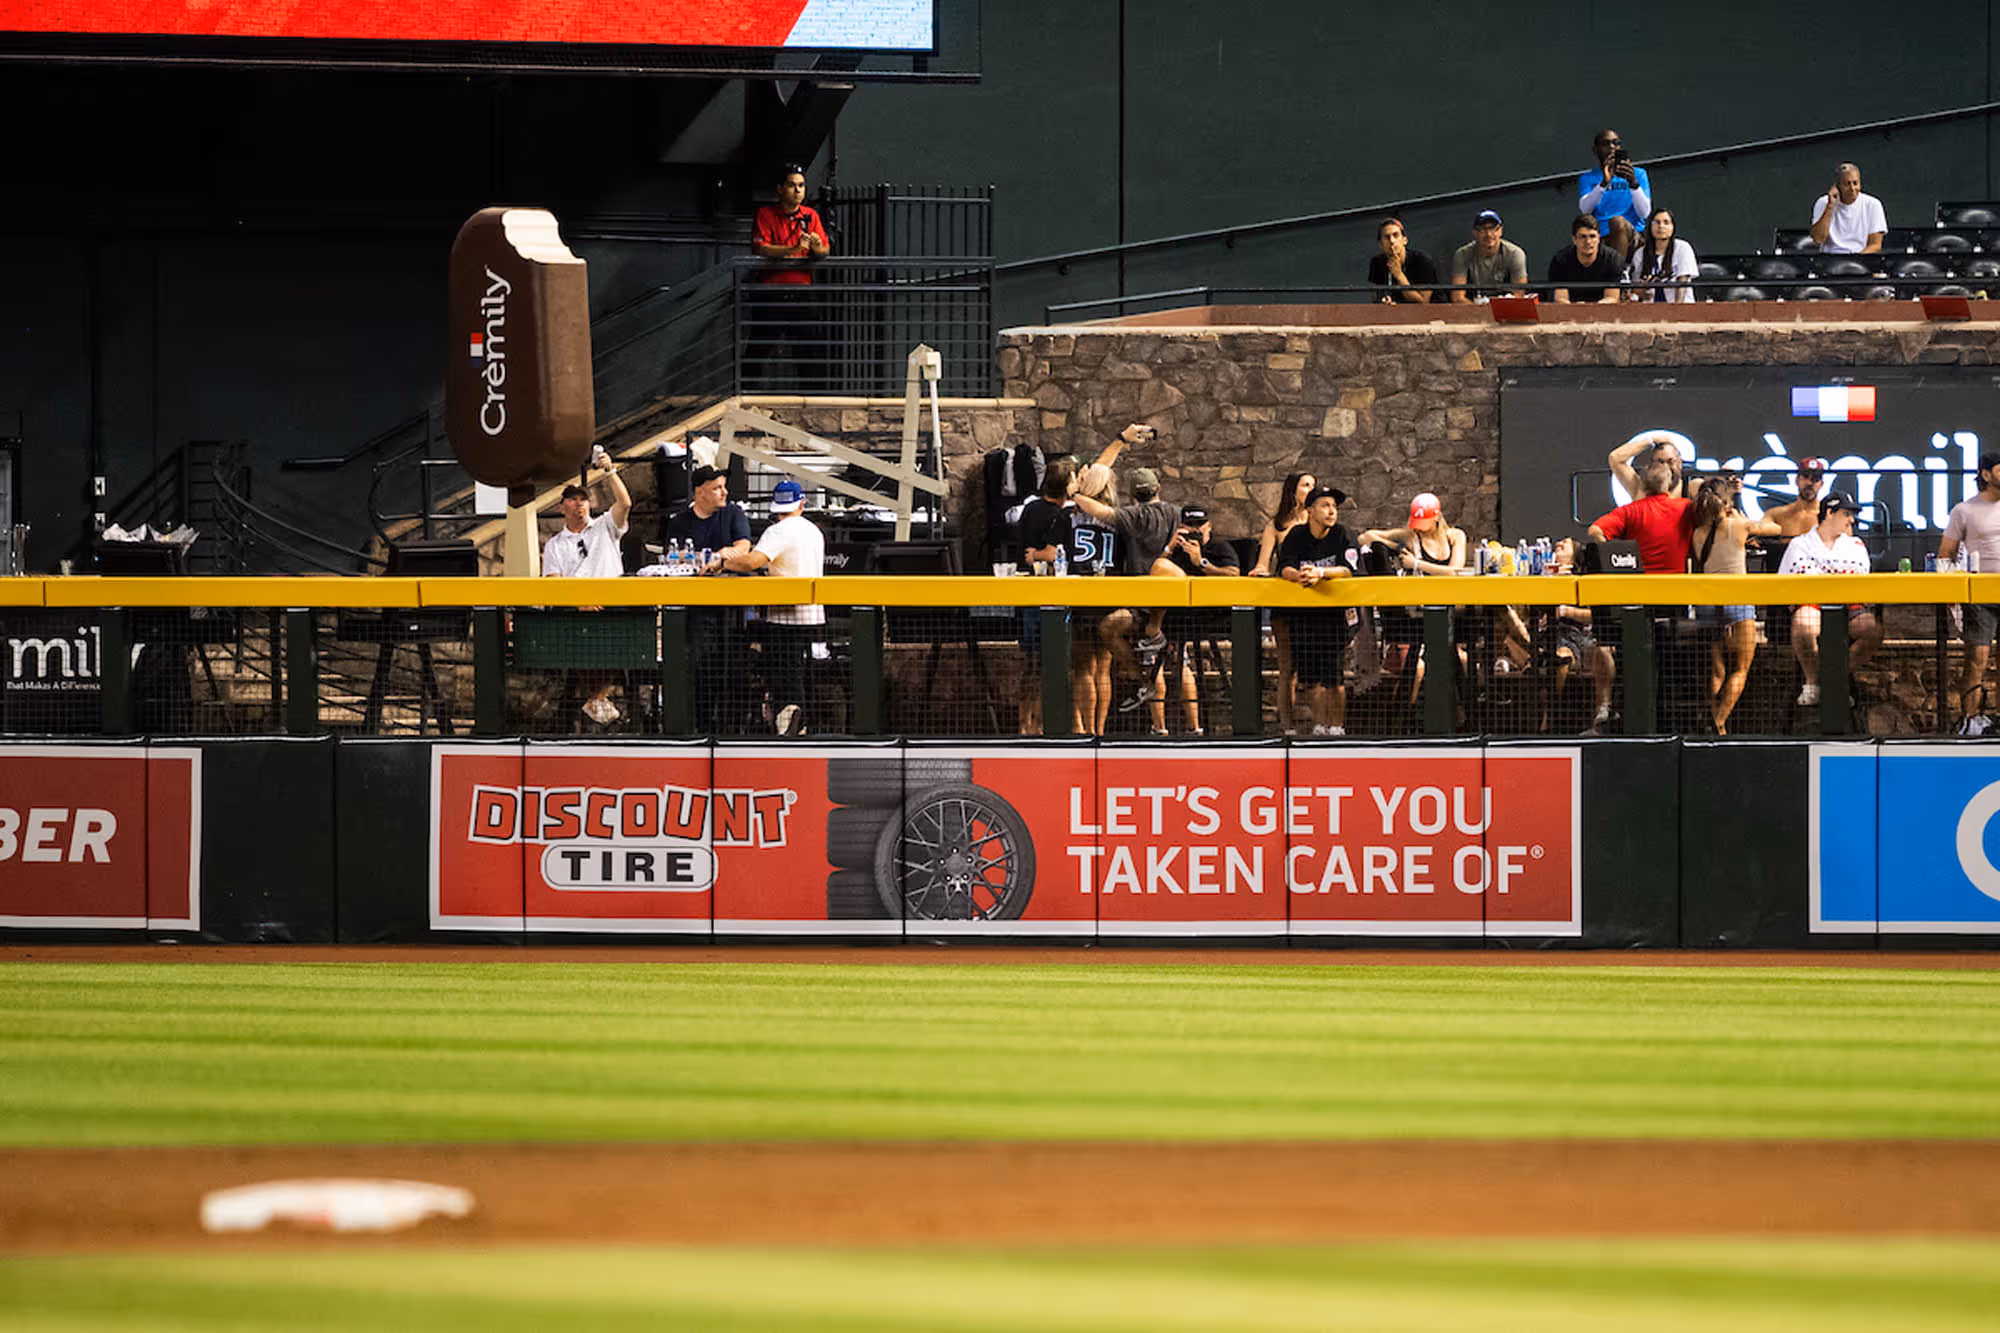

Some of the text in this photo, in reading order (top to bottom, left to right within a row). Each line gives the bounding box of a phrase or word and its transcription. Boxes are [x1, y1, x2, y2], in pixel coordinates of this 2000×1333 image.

[480, 264, 512, 436] Crèmily
[1073, 527, 1115, 567] 51
[1070, 786, 1493, 835] LET'S GET YOU
[561, 850, 694, 883] TIRE
[1067, 846, 1264, 894] TAKEN
[1285, 846, 1434, 894] CARE
